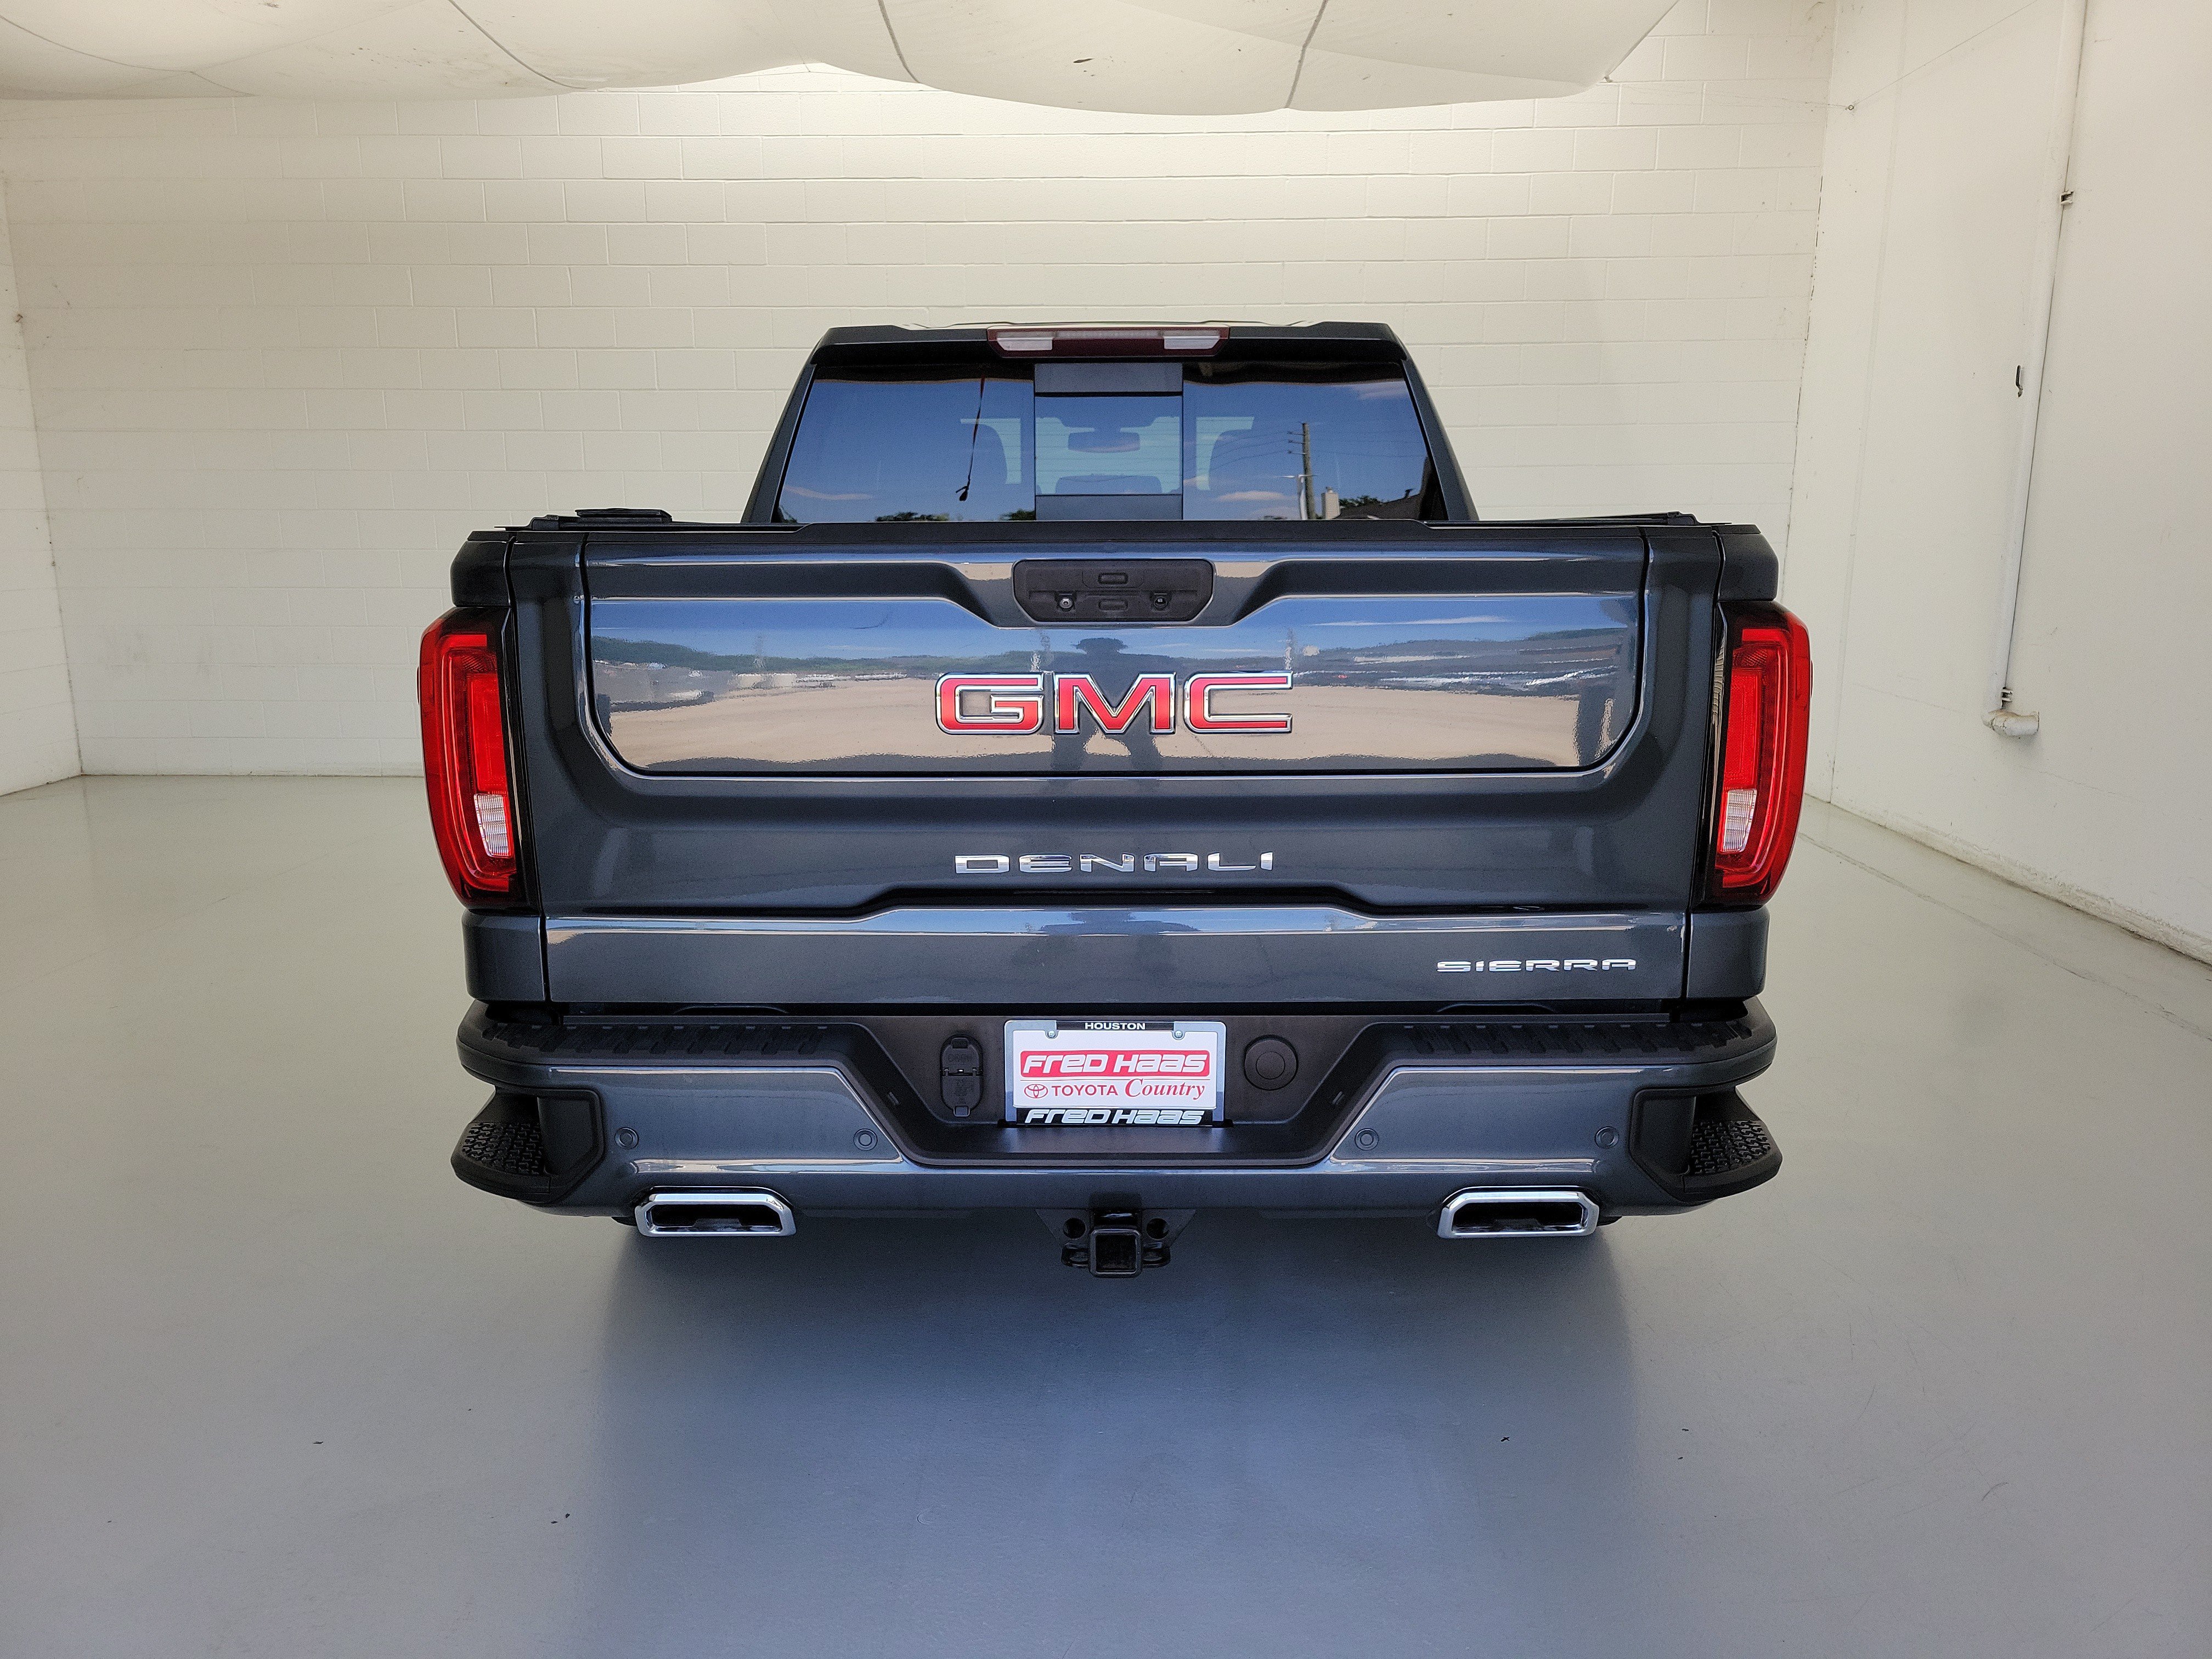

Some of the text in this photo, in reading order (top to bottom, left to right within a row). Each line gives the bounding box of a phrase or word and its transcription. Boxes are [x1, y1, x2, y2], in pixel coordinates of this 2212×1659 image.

[936, 671, 1294, 735] GMC
[954, 851, 1273, 874] DENALI
[1436, 958, 1637, 973] SIERRA
[1052, 1078, 1205, 1101] TOYOTA Country
